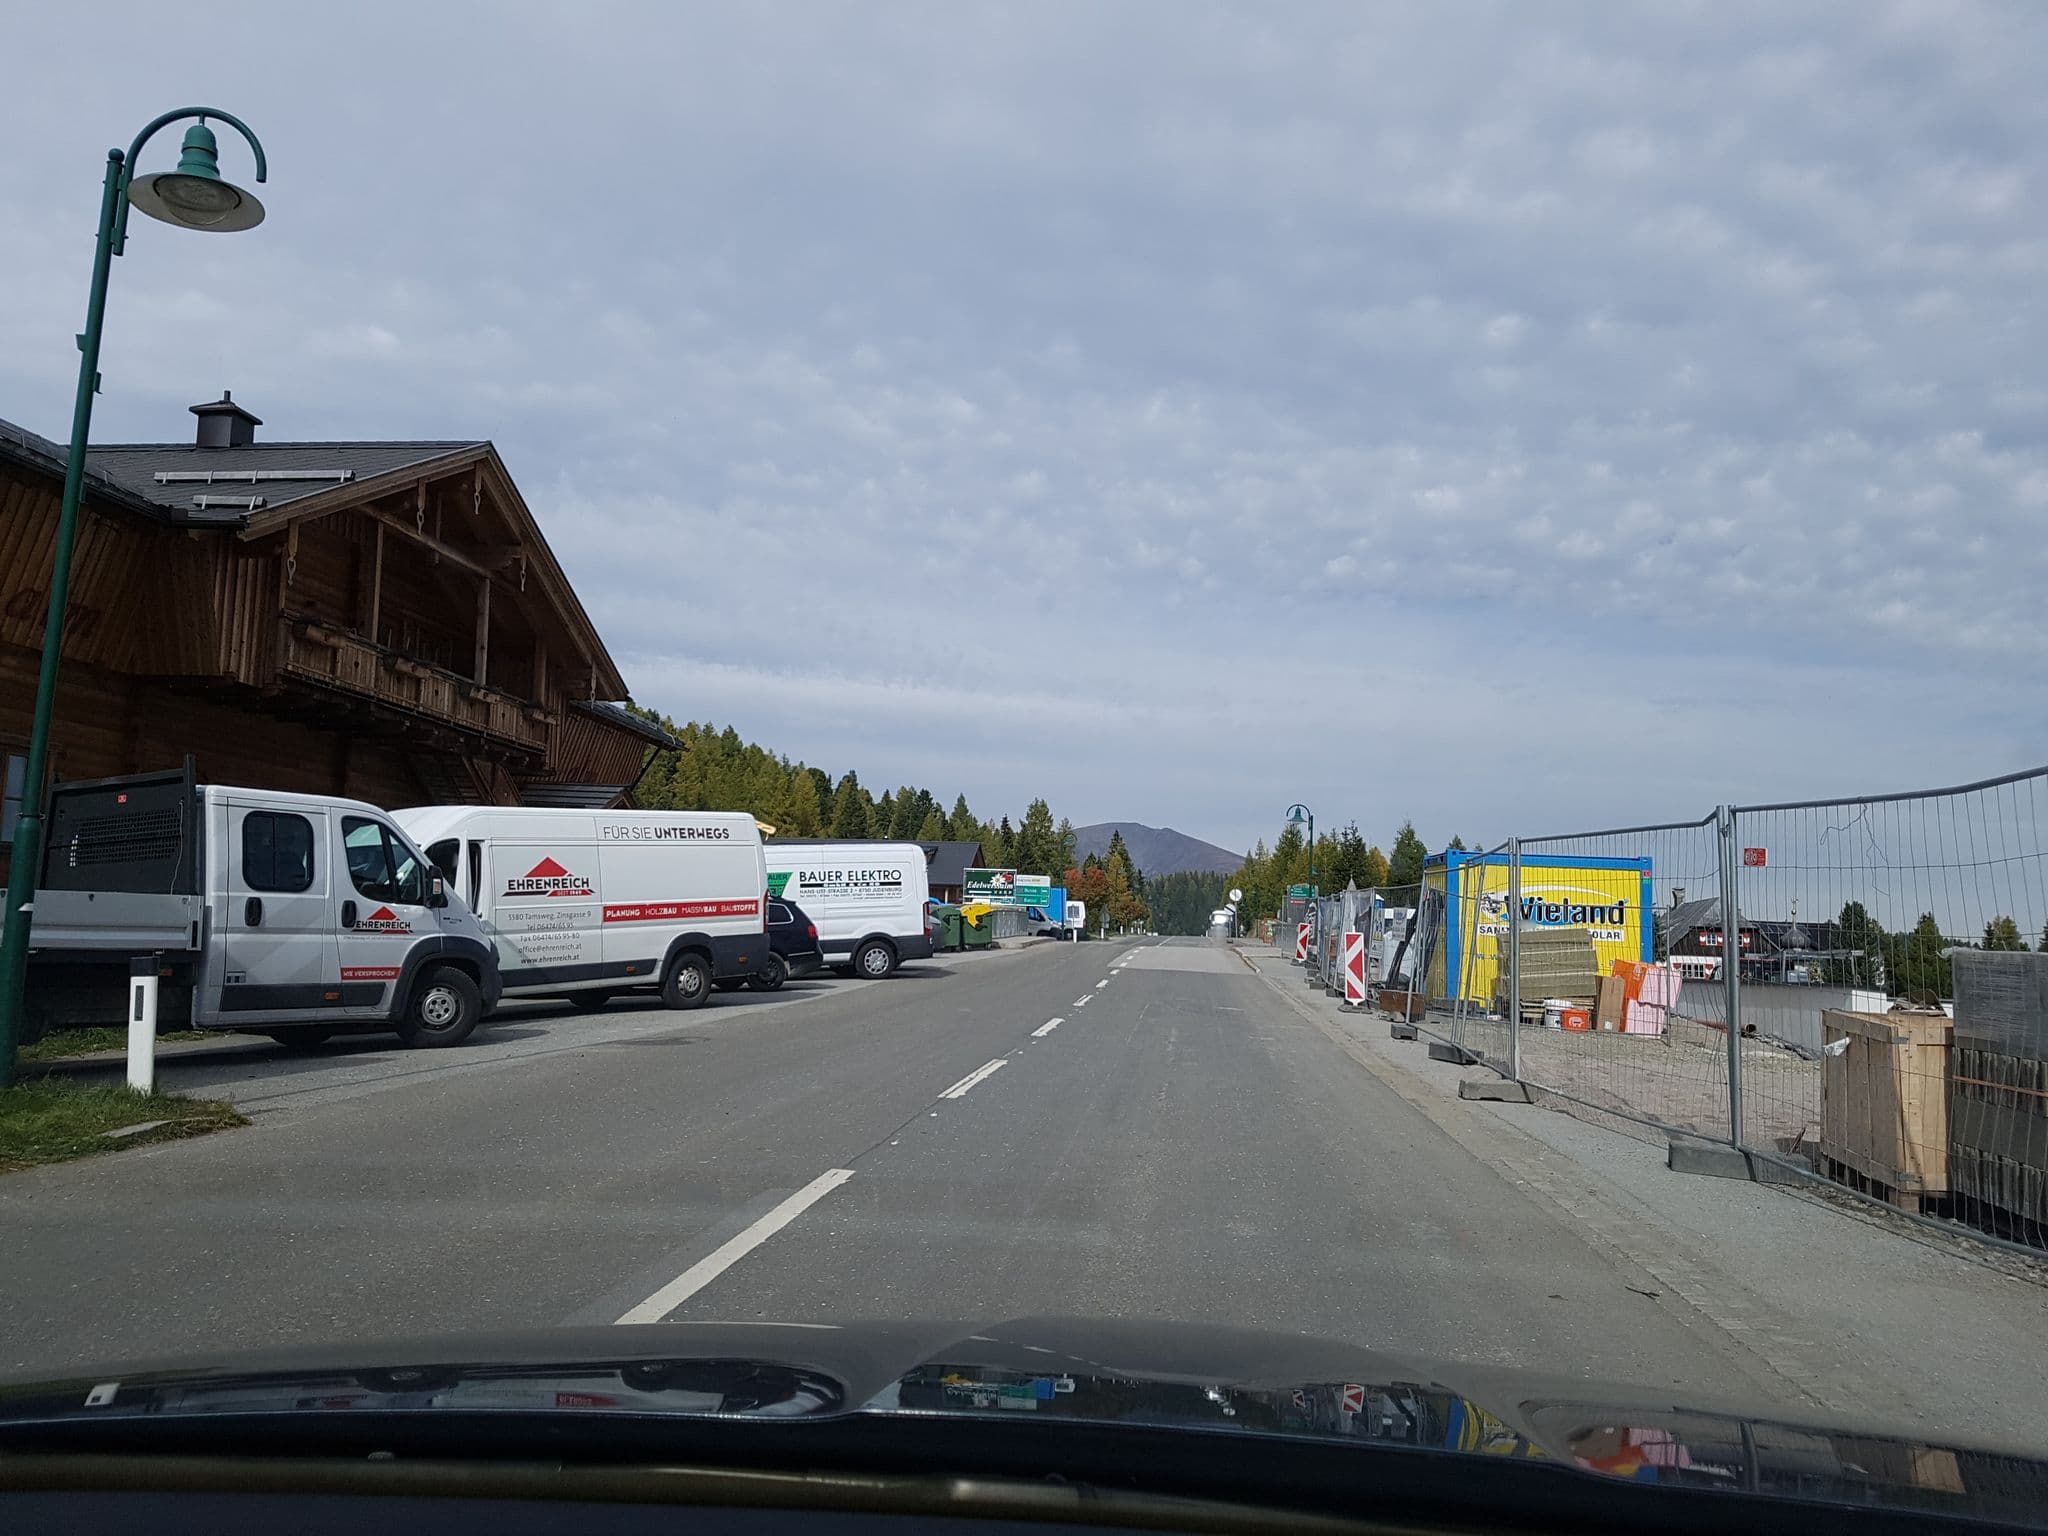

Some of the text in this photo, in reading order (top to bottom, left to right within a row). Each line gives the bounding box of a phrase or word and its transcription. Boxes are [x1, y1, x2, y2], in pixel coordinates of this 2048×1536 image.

[603, 825, 730, 839] FÜR SIE UNTERWEGS
[767, 872, 788, 880] AUER
[799, 869, 902, 883] BAUER ELEKTRO
[508, 877, 589, 890] EHRENREICH
[606, 903, 756, 918] PLANUNG HOLZBAU MASSIVBAU BAUSTOFFE
[1503, 895, 1626, 925] Wieland
[356, 921, 411, 929] EHRENREICH
[1587, 930, 1621, 940] OLAR
[518, 943, 582, 954] office@ehrenreich.at
[521, 954, 580, 964] www.ehrenreich.at
